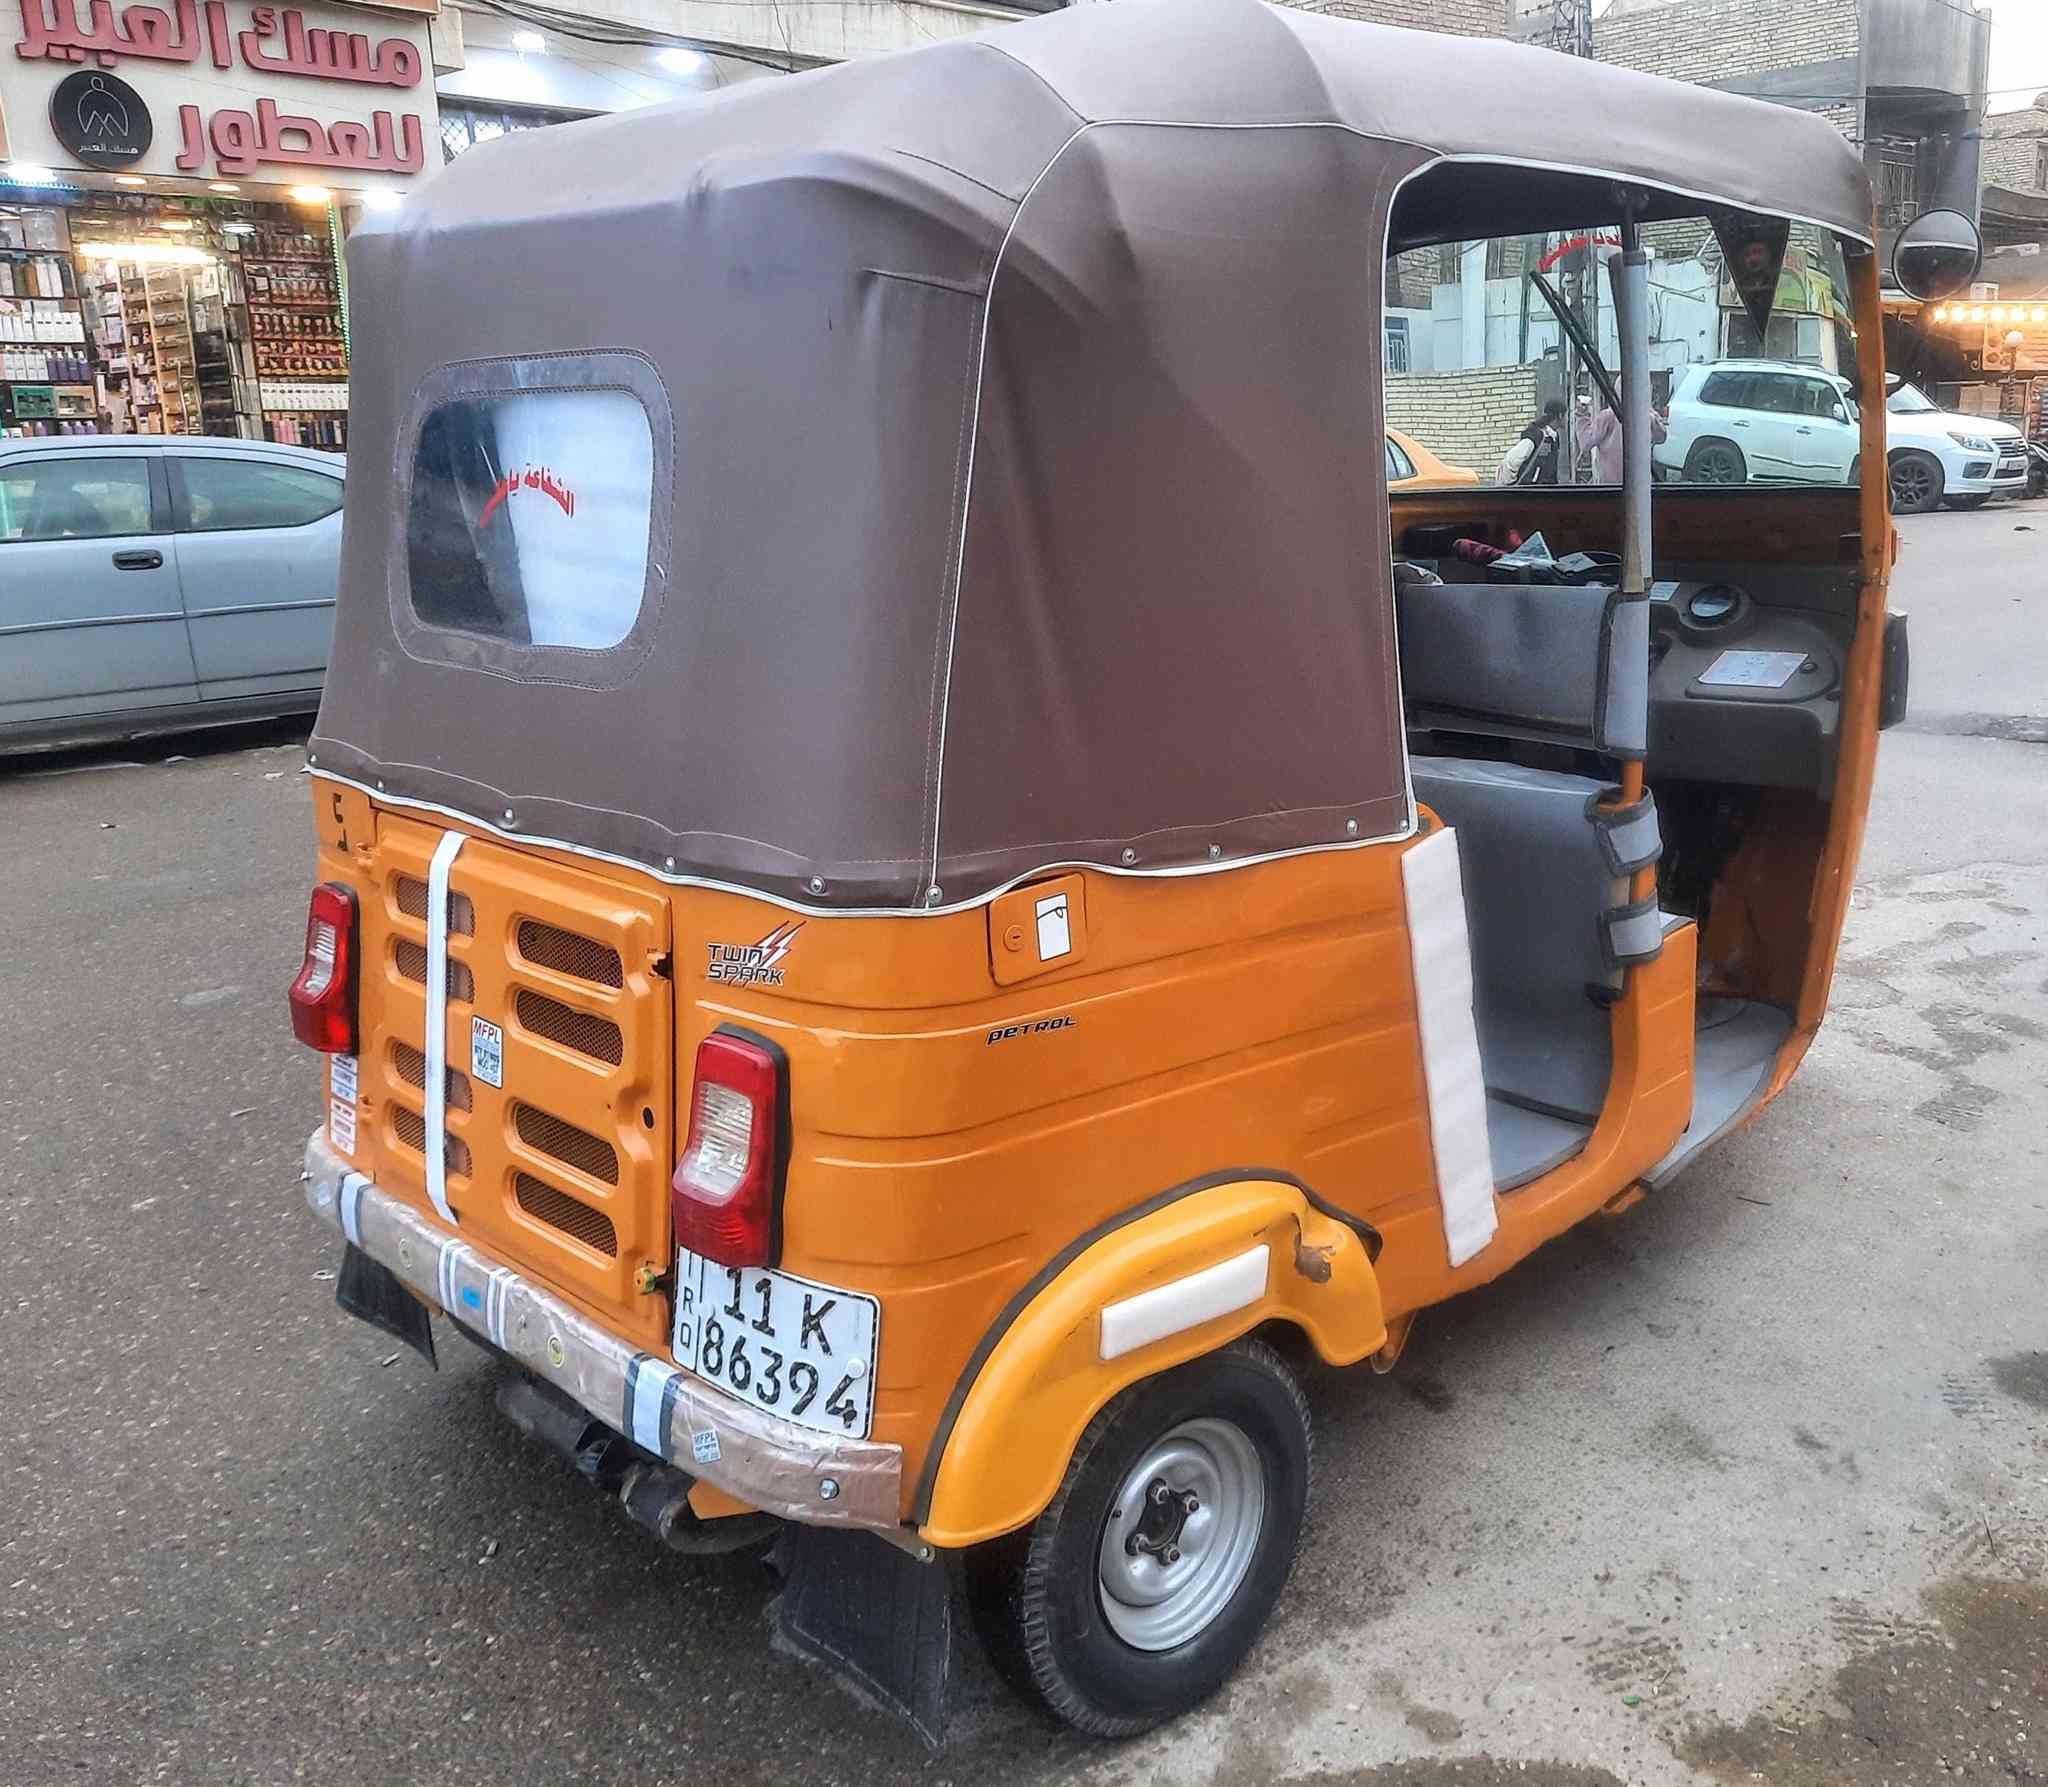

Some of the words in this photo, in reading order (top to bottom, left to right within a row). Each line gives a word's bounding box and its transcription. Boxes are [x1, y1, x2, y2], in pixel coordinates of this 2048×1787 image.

[15, 0, 232, 68] العبير
[239, 7, 422, 88] مسك
[176, 98, 424, 176] للعطور
[706, 963, 784, 985] SPARK
[707, 943, 763, 965] TWIN
[473, 1019, 500, 1045] MFPL
[724, 1268, 775, 1337] 11
[800, 1293, 837, 1356] K
[702, 1317, 858, 1429] 86394
